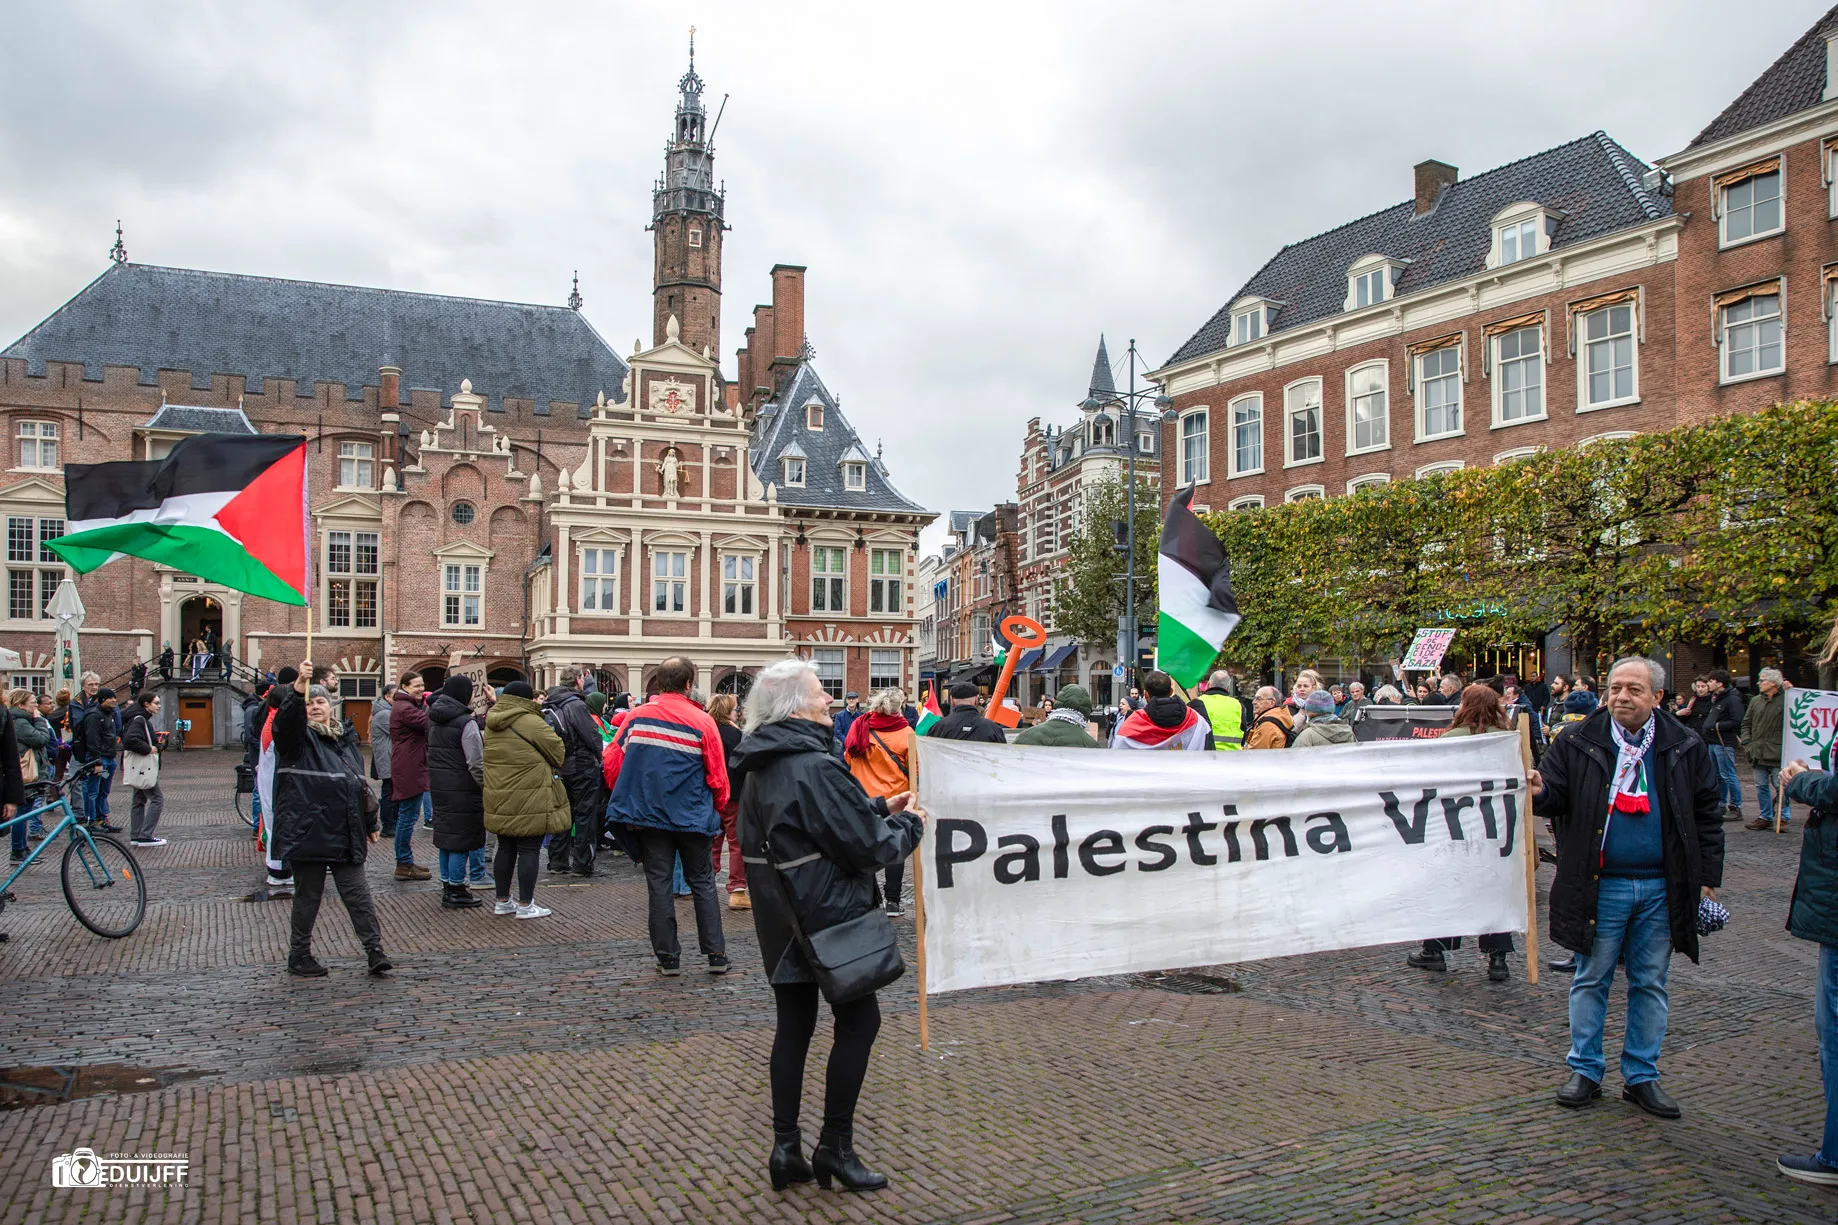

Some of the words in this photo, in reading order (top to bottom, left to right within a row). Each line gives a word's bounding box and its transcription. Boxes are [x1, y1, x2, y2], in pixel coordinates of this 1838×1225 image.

[1421, 629, 1450, 638] STOP
[1407, 659, 1437, 667] GAZA
[457, 669, 484, 683] TOP
[1412, 726, 1448, 739] PALESTI
[935, 804, 1352, 889] Palestina
[1379, 778, 1519, 857] Vrij
